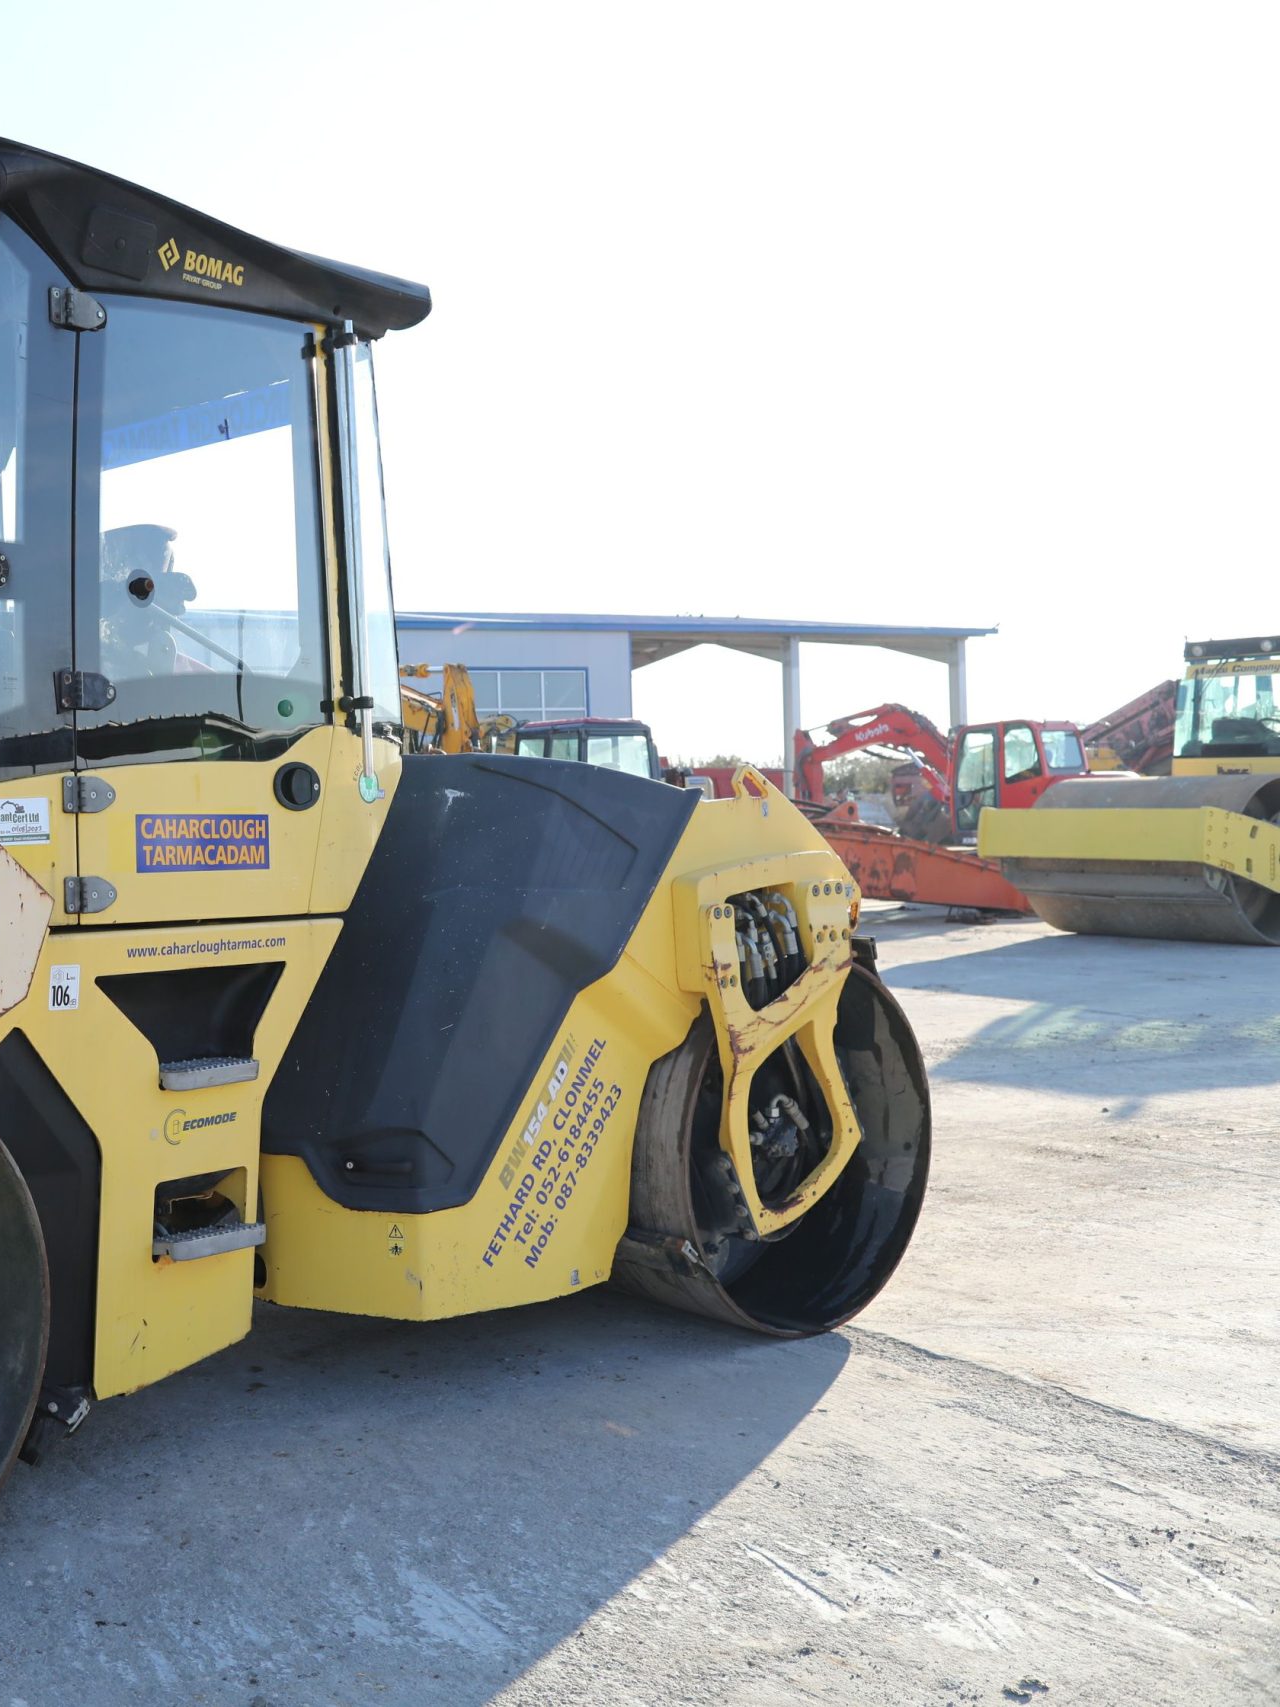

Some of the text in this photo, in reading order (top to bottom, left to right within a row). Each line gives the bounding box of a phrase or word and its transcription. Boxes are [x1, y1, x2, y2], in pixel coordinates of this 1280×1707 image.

[184, 250, 244, 286] BOMAG
[182, 273, 222, 290] FAYAT GROUP
[29, 812, 39, 823] Ltd
[141, 818, 266, 839] CAHARCLOUGH
[142, 844, 265, 866] TARMACADAM
[127, 937, 286, 959] www.caharcloughtarmac.com
[52, 985, 70, 1006] 106
[183, 1112, 237, 1131] ECOMODE
[482, 1038, 607, 1268] FETHARD RD, CLONMEL
[514, 1078, 605, 1246] Tel: 052-6184455
[525, 1084, 622, 1268] Mob: 087-8339423
